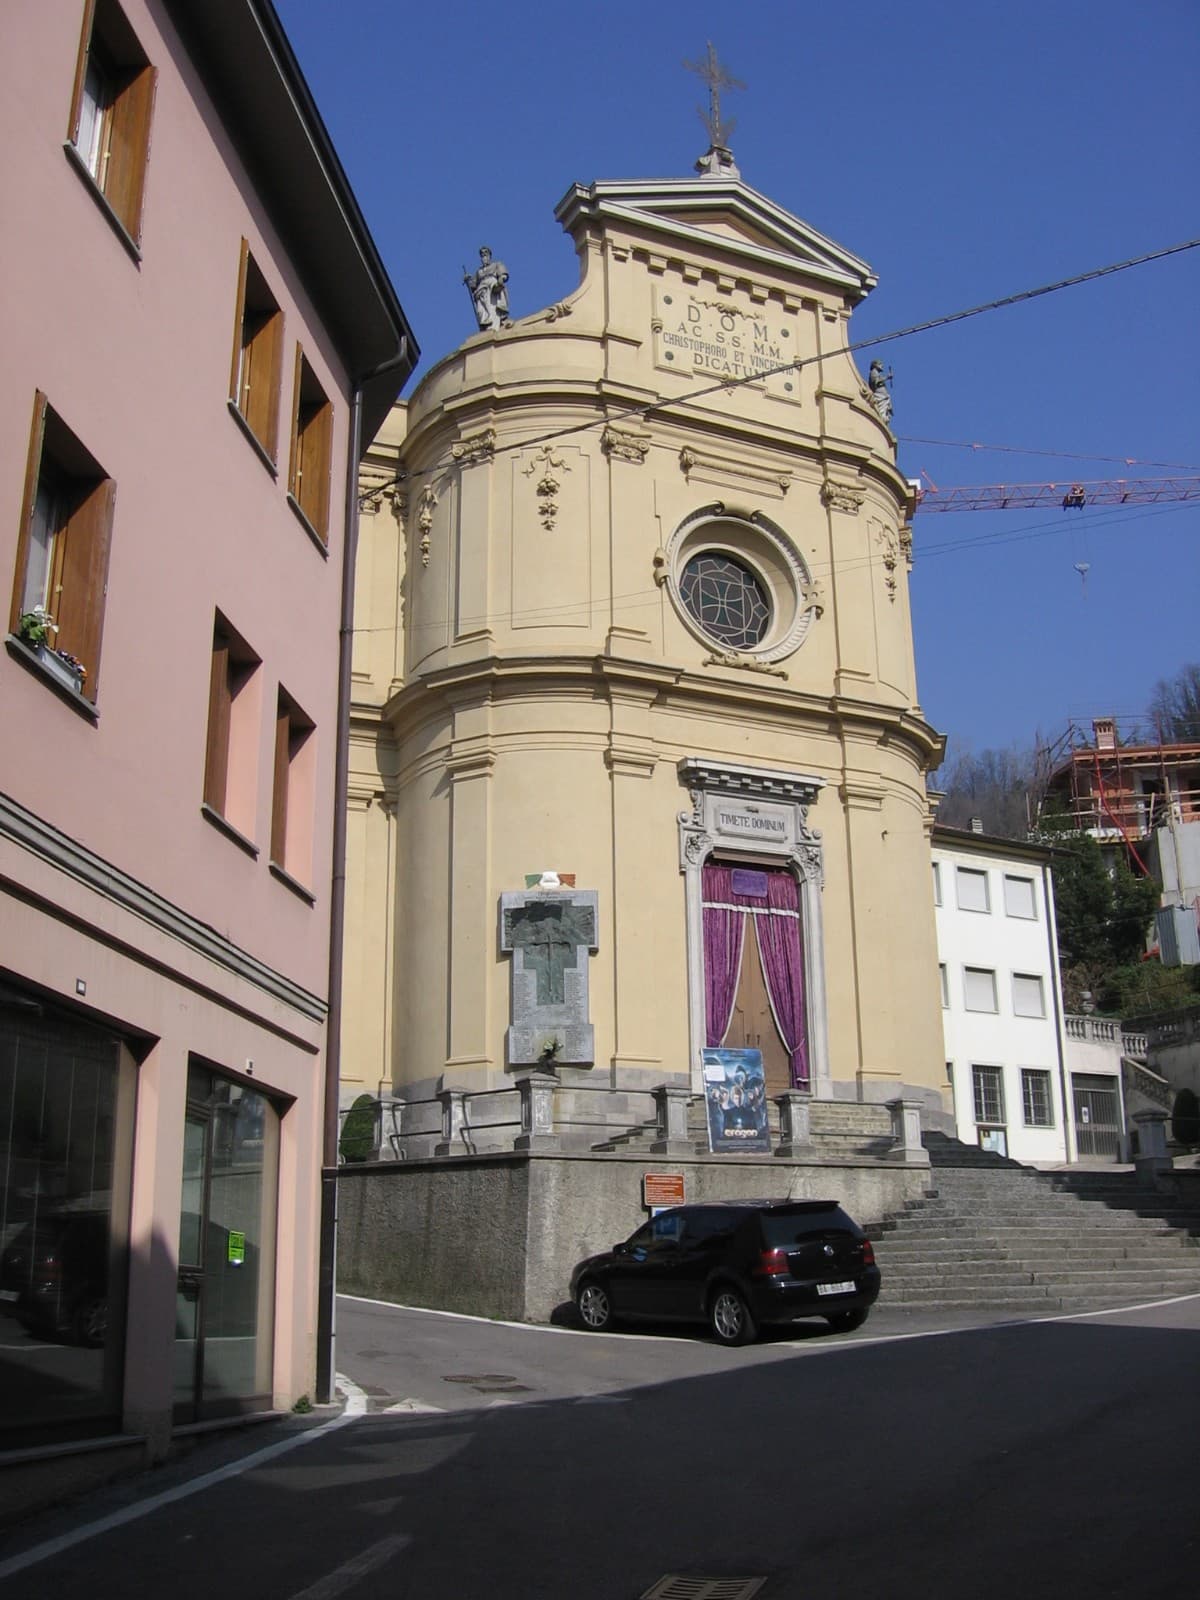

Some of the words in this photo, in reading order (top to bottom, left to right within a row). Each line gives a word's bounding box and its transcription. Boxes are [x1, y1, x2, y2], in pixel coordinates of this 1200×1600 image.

[662, 332, 727, 359] CHRISTOPHORO
[734, 351, 745, 364] ET
[720, 813, 750, 828] TIMETE
[751, 817, 785, 832] DOMINUM
